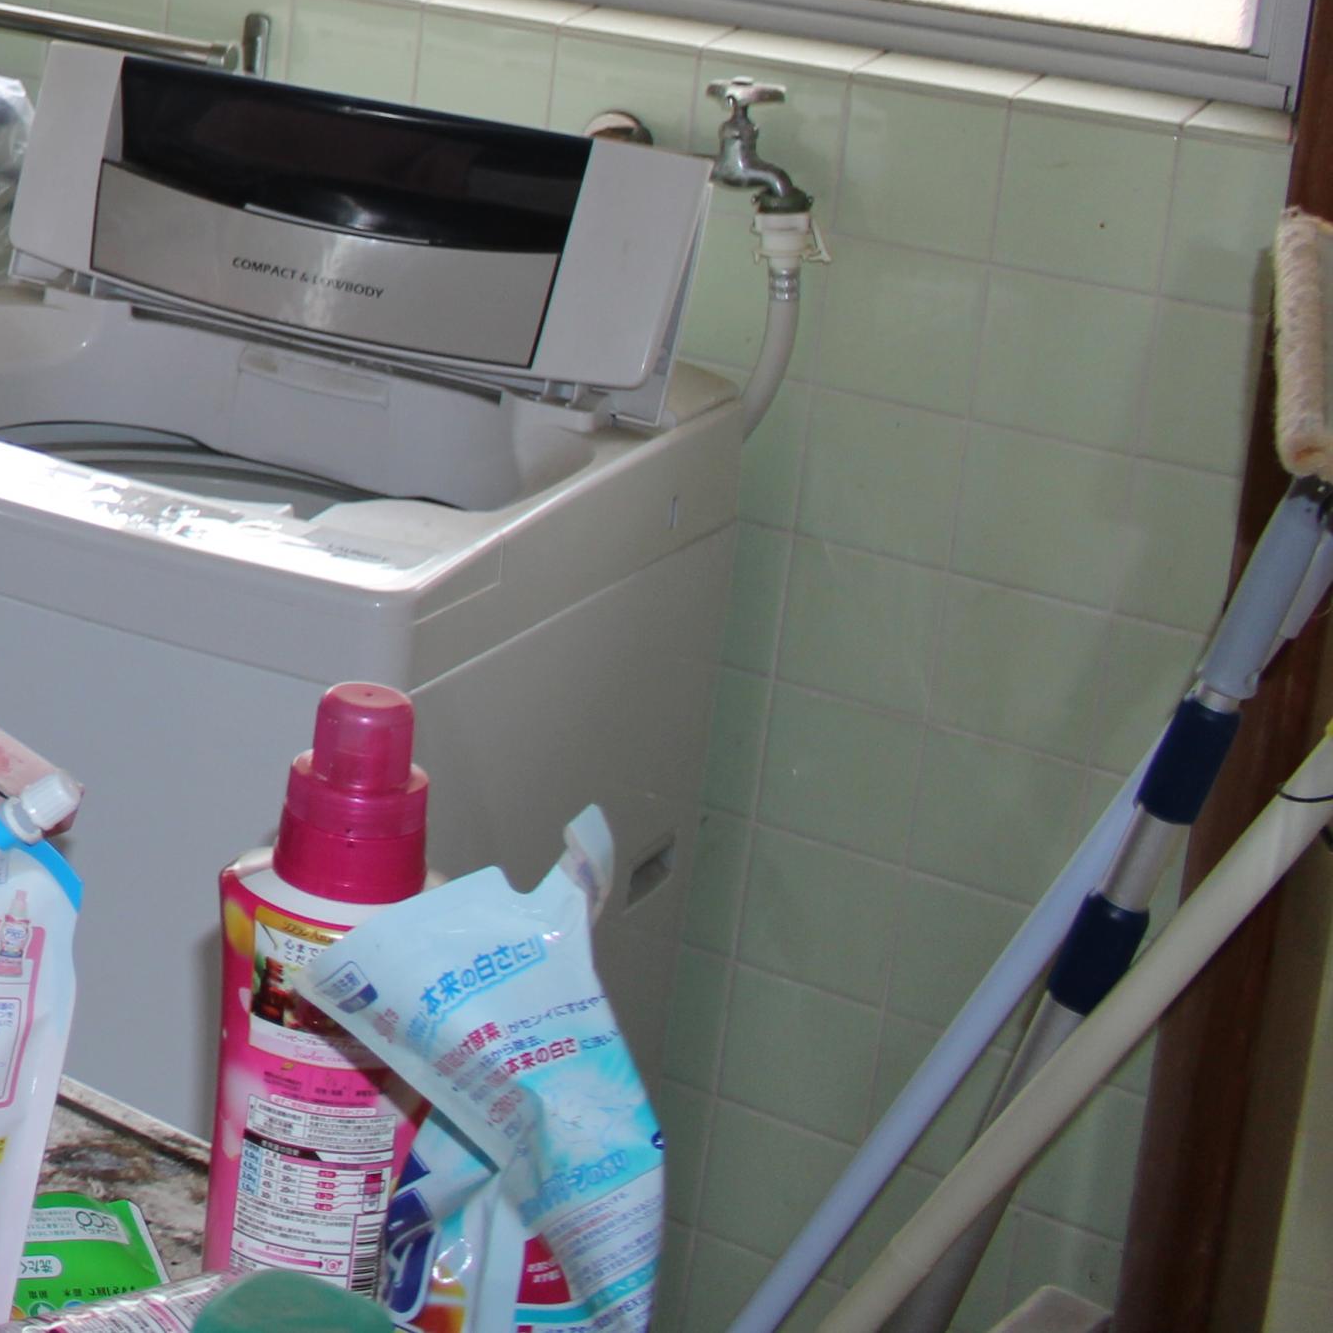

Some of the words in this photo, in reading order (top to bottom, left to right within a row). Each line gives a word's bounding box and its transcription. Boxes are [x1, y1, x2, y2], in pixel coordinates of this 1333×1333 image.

[232, 256, 297, 280] COMPACT
[300, 273, 309, 283] &
[283, 937, 326, 958] 心まで
[20, 1258, 53, 1274] 洗たく
